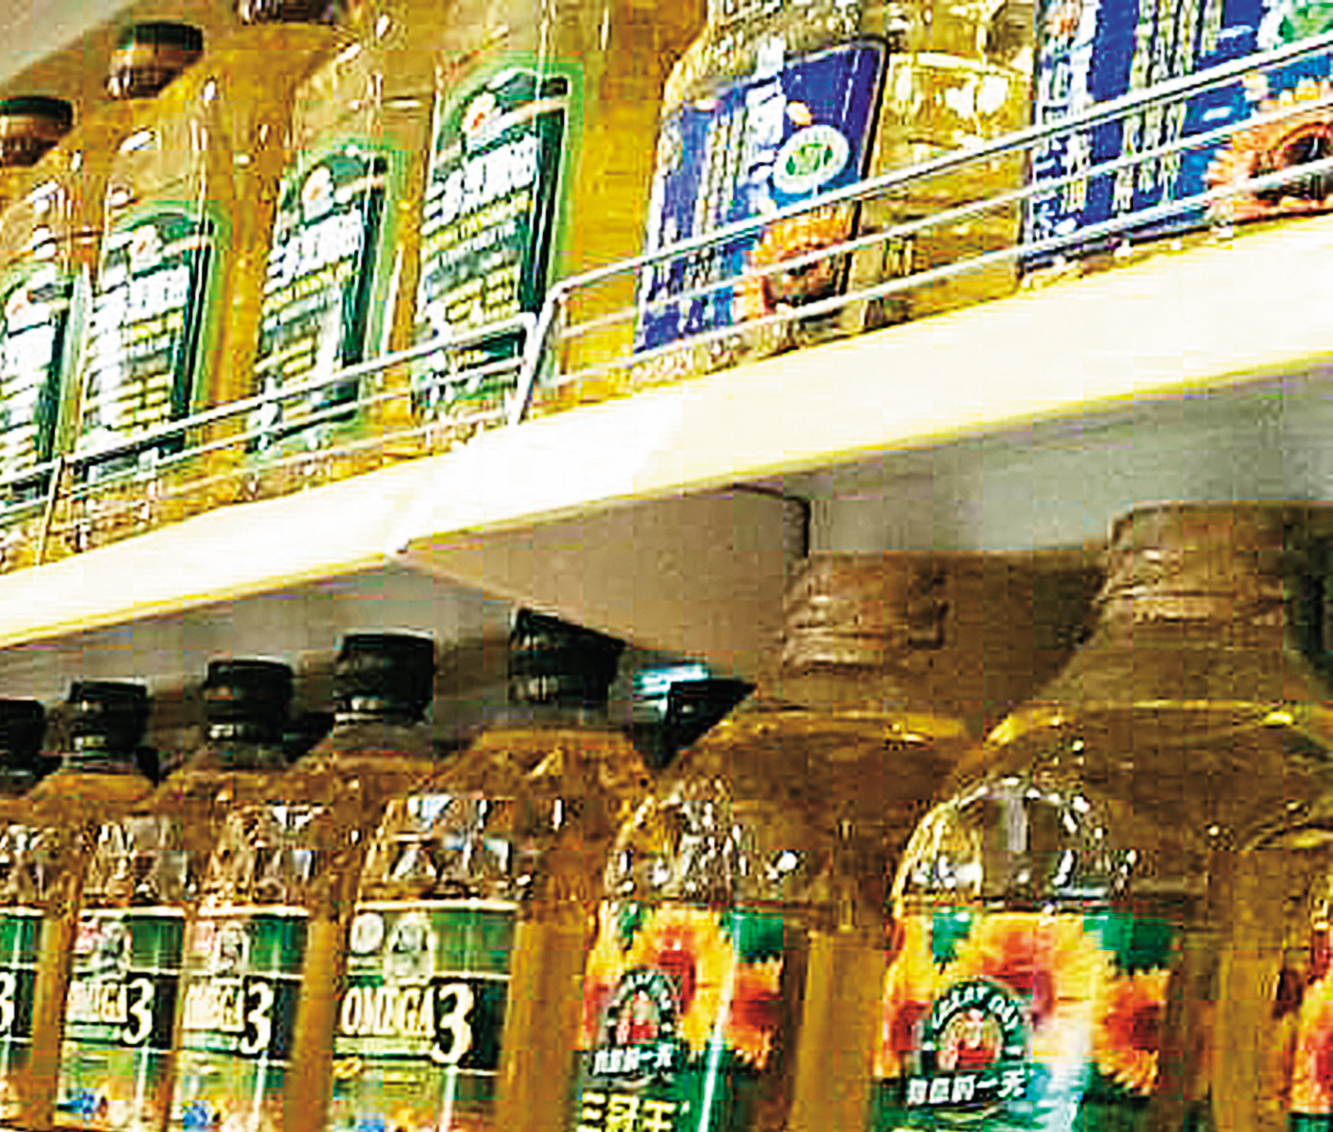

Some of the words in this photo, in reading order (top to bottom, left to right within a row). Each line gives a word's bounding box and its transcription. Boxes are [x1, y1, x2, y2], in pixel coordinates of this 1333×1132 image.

[122, 977, 155, 1045] 3
[239, 980, 275, 1055] 3
[340, 985, 435, 1036] OMEGA
[431, 982, 476, 1064] 3
